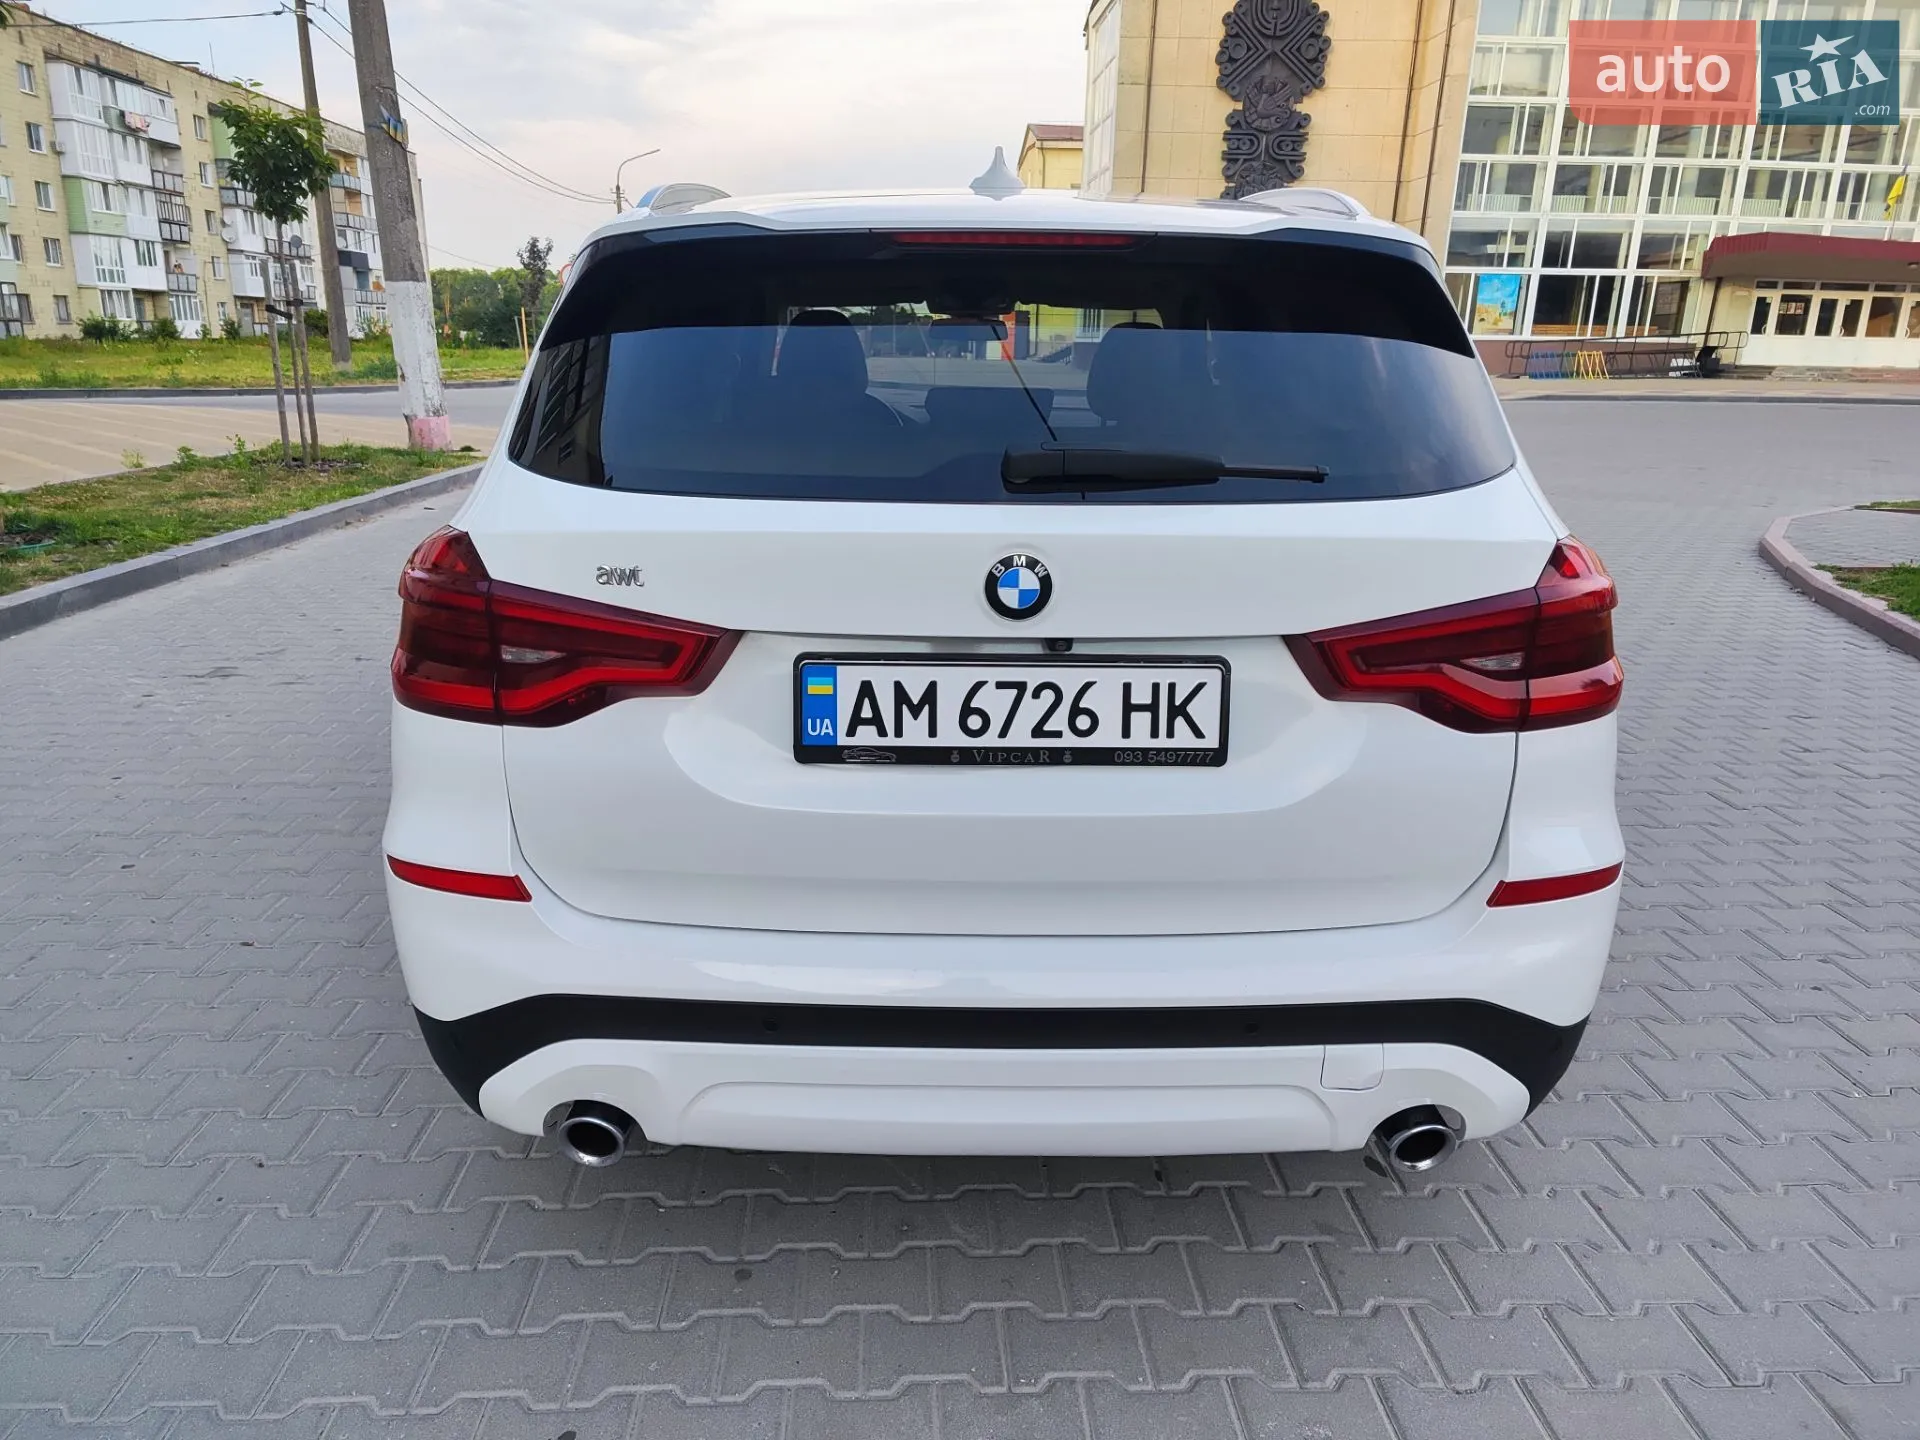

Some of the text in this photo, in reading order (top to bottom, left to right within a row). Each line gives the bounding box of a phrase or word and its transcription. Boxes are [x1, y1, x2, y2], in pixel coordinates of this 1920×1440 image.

[596, 565, 645, 587] awt
[991, 555, 1048, 578] BMW
[845, 680, 1208, 739] AM 6726 HK
[807, 719, 834, 736] UA
[1114, 751, 1214, 763] 093 5497777
